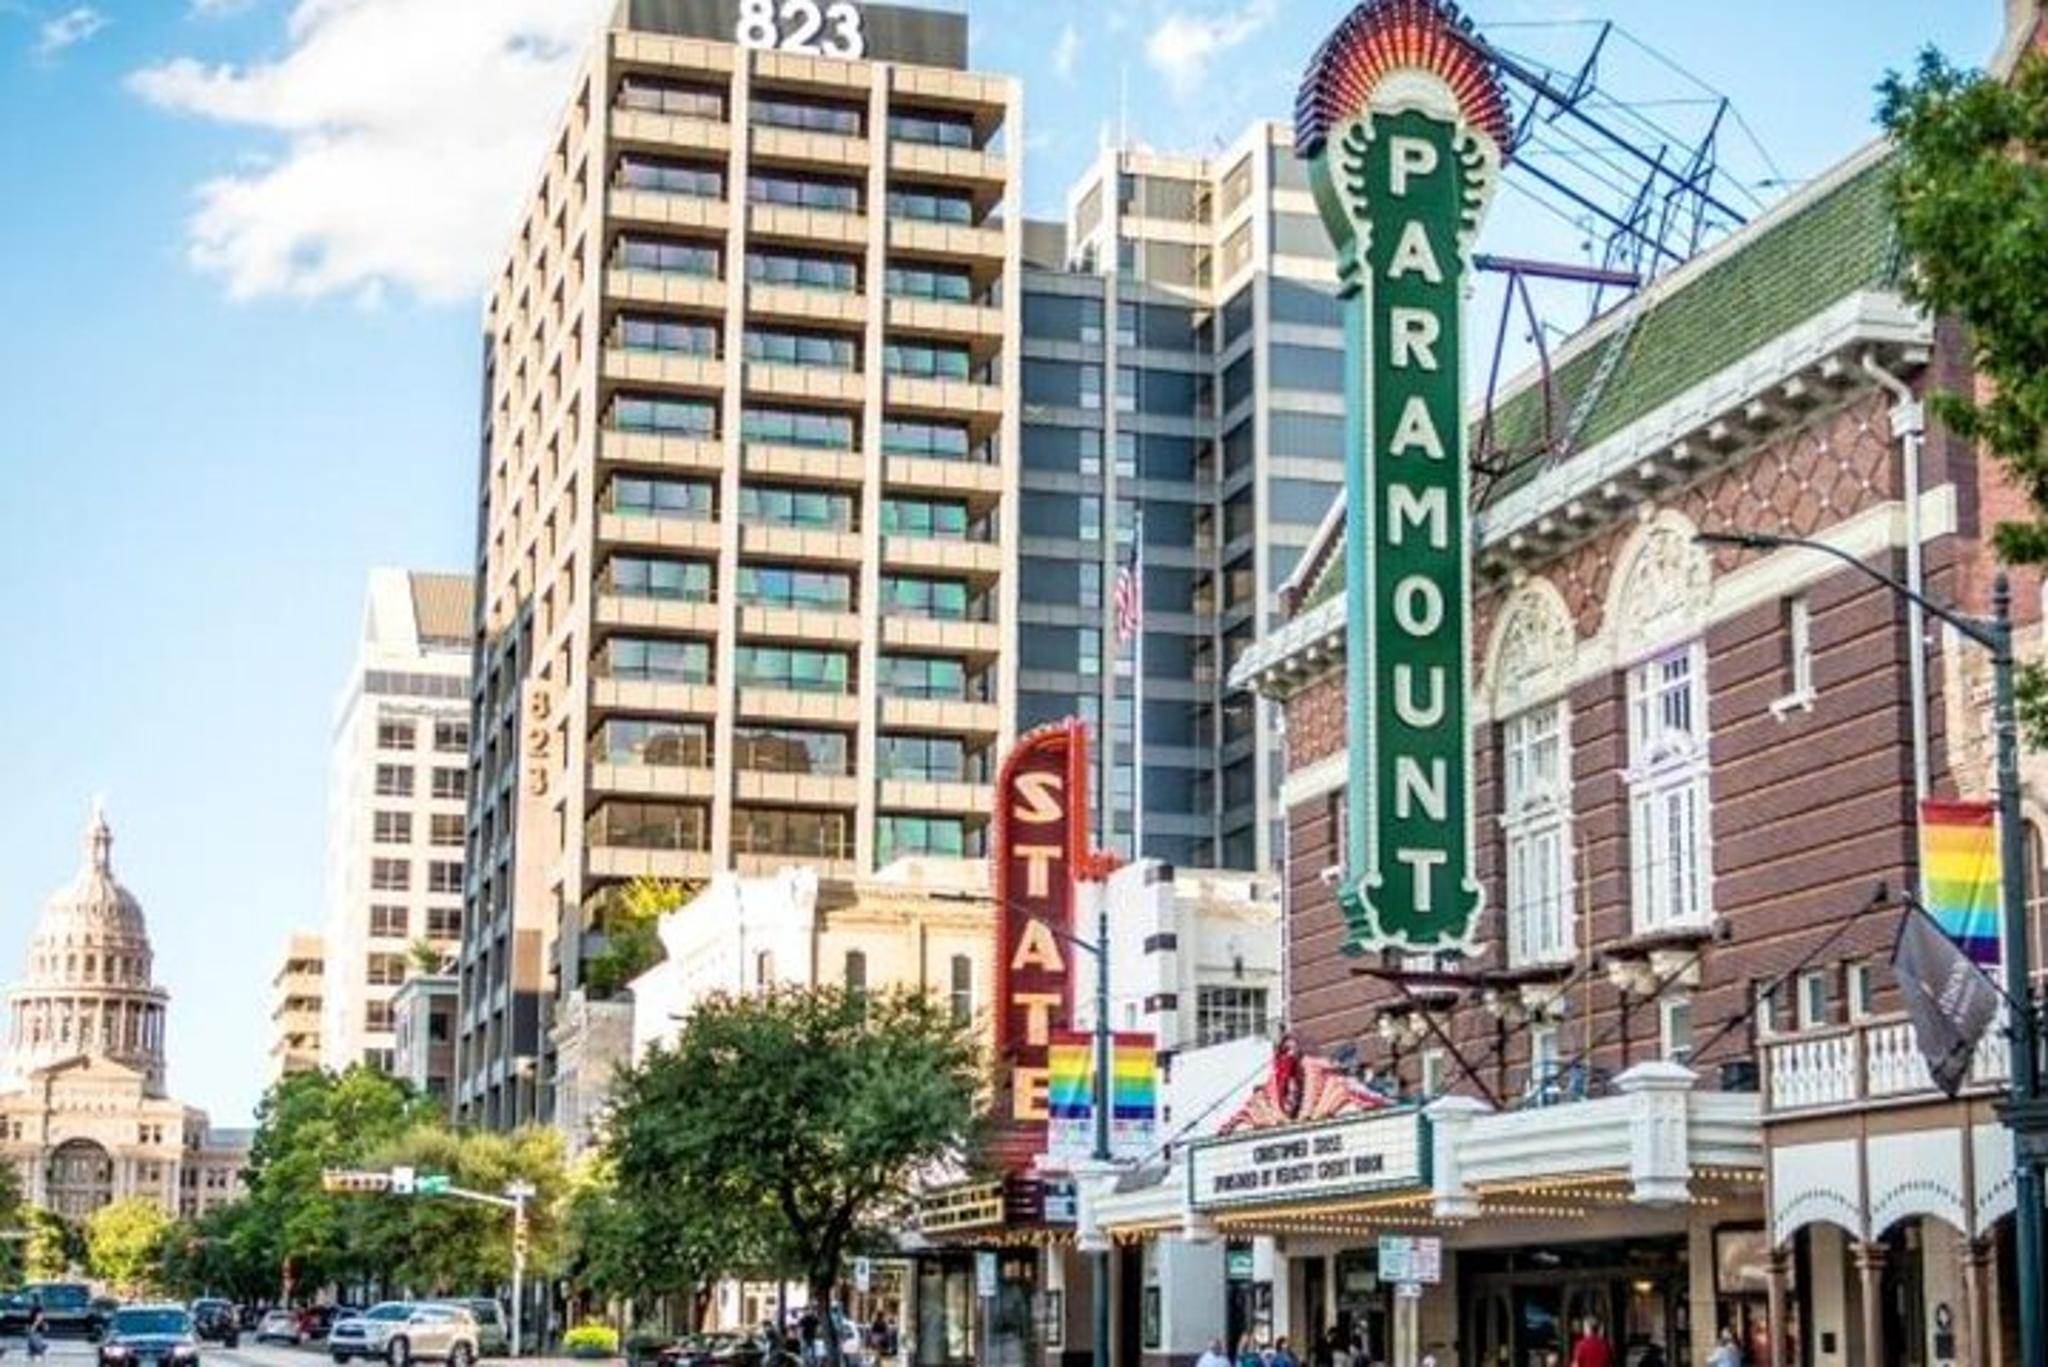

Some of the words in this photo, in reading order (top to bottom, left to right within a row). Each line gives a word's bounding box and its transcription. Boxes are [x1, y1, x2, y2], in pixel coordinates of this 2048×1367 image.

[737, 0, 863, 58] 823
[1387, 135, 1448, 913] PARAMOUNT
[529, 691, 551, 796] 823
[1011, 771, 1065, 1120] STATE
